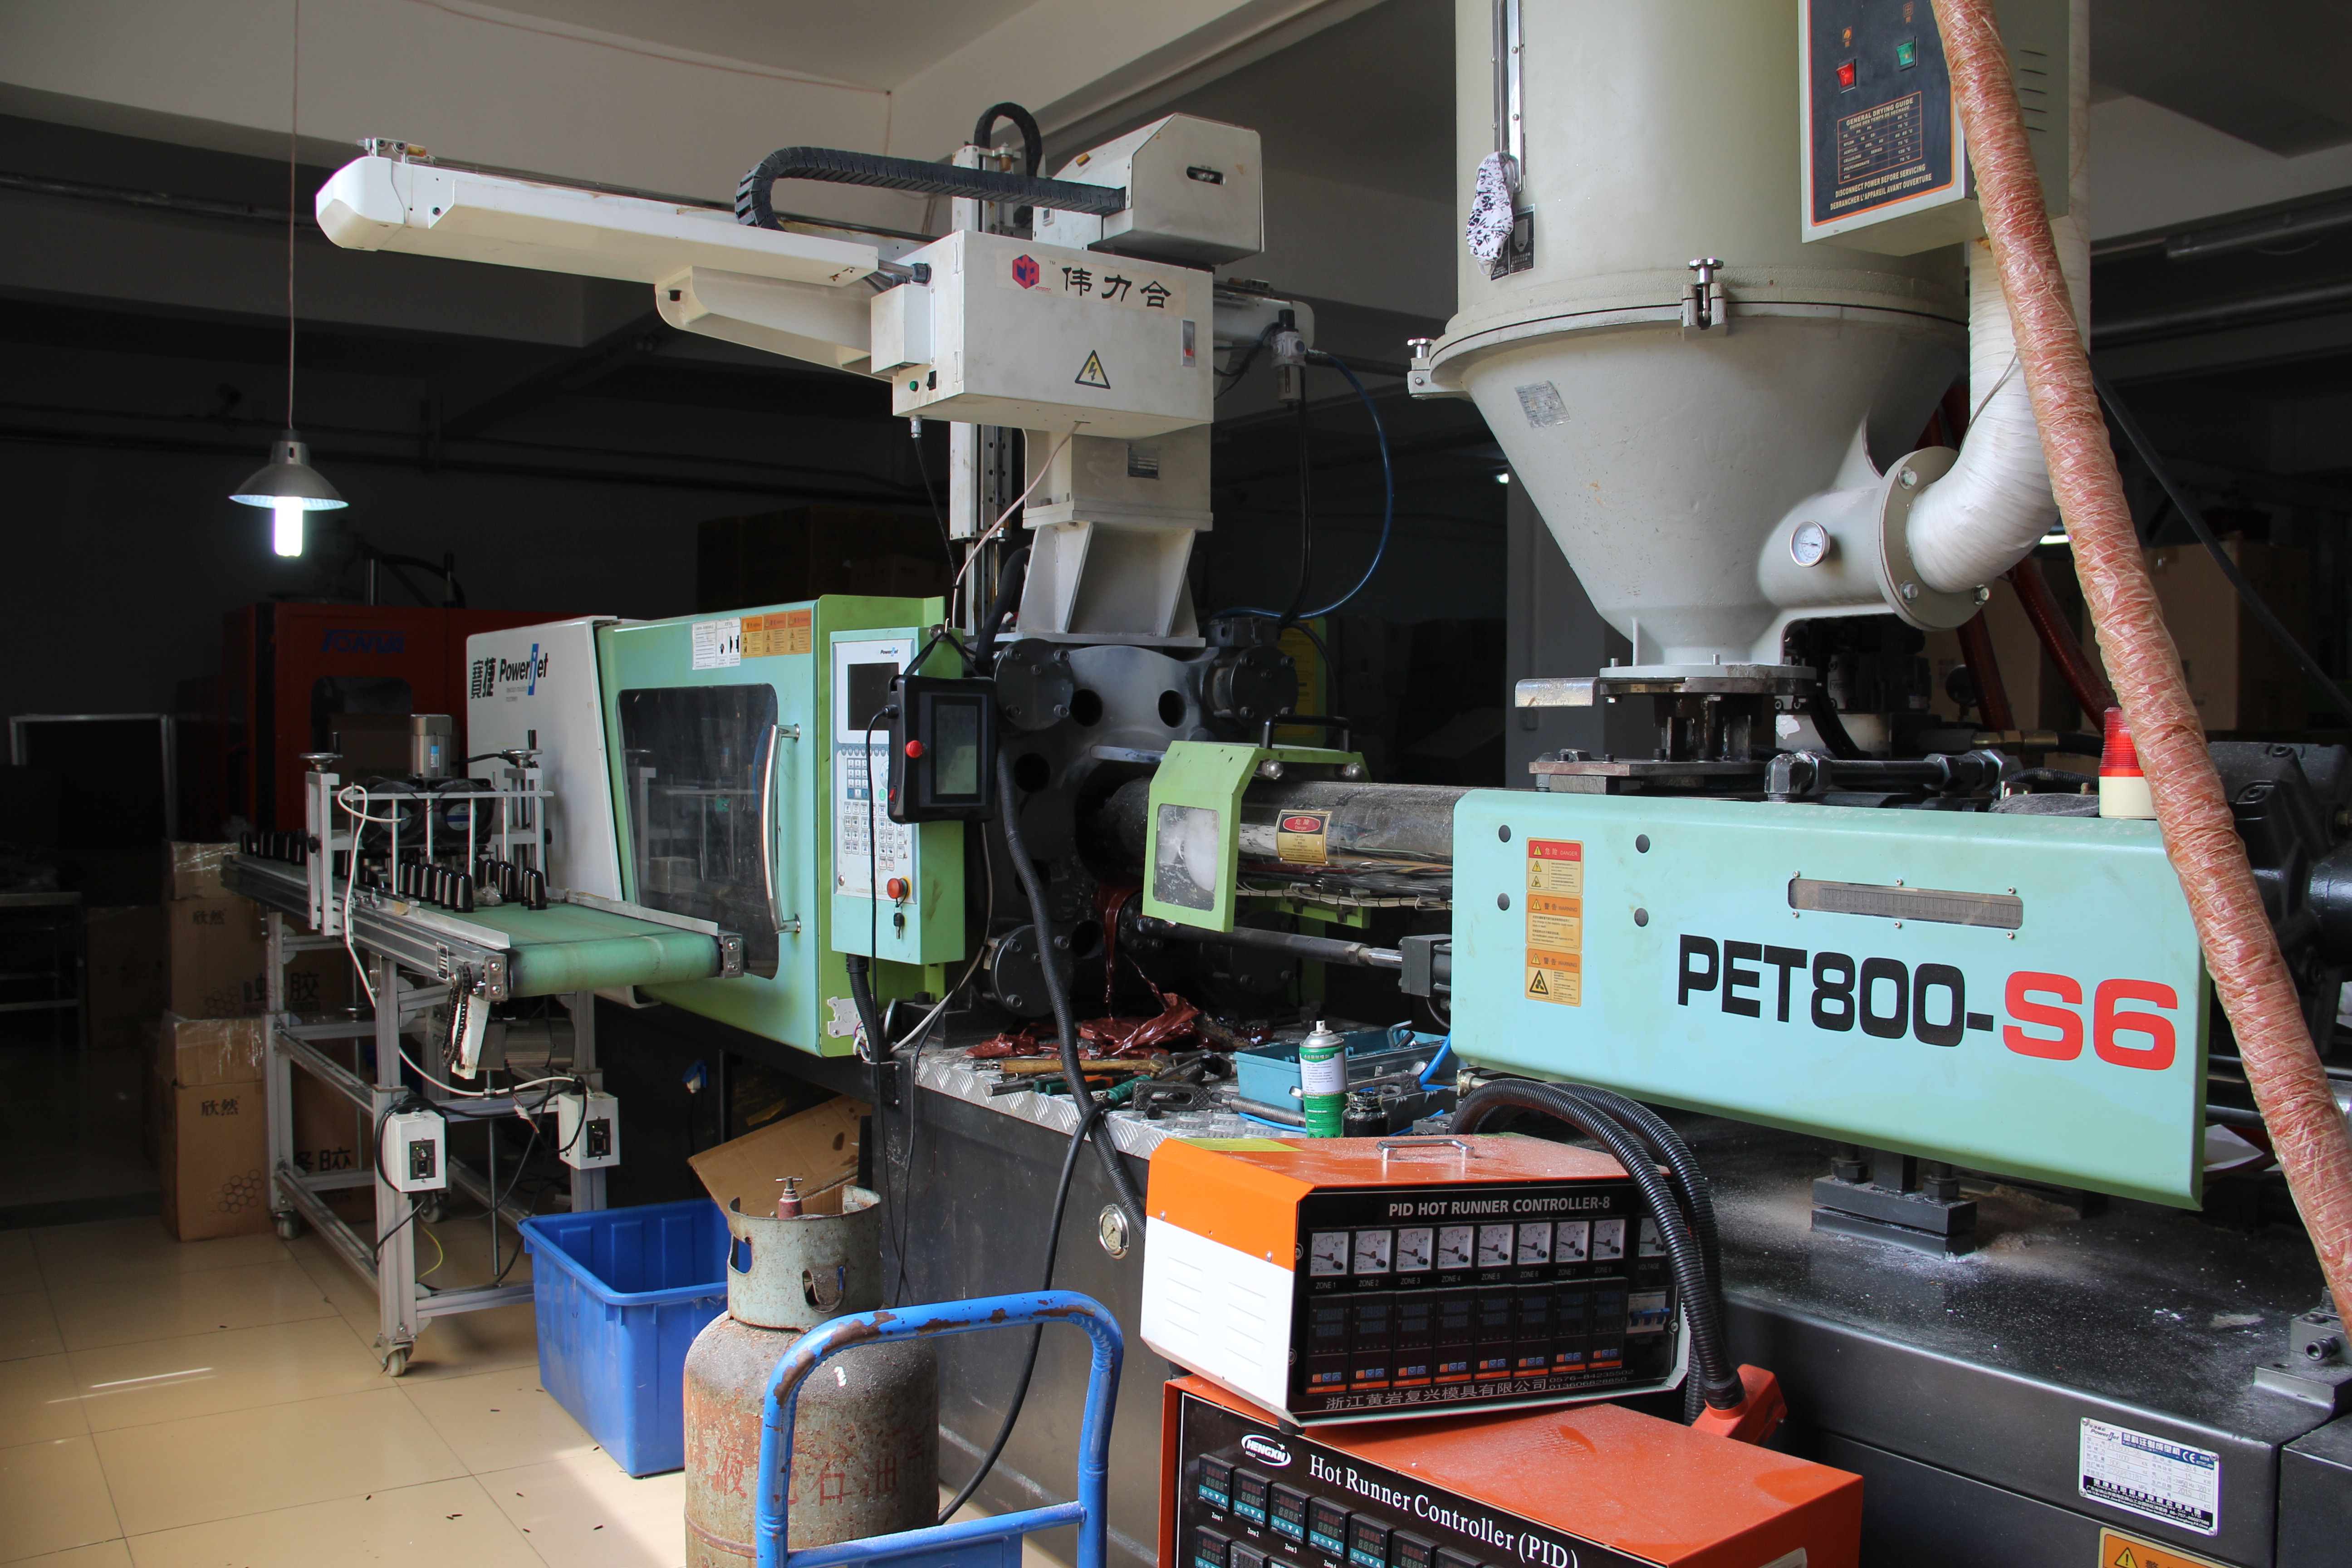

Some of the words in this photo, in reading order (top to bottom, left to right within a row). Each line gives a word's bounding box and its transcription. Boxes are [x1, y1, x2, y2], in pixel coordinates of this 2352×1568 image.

[1846, 113, 1872, 126] GENERAL
[1873, 104, 1894, 117] DRYING
[1895, 97, 1913, 109] GUIDE
[1891, 105, 1910, 116] SECHAGE
[1843, 160, 1870, 171] POLYCARBONATE
[1835, 183, 1864, 198] DISCONNECT
[1864, 178, 1880, 189] POWER
[1881, 172, 1899, 184] BEFORE
[1900, 163, 1926, 178] SERVICING
[1830, 195, 1860, 210] DEBRANCHER
[1860, 187, 1886, 201] L'APPAREIL
[1887, 183, 1902, 194] AVANT
[1902, 173, 1932, 188] OUVERTURE
[1062, 267, 1171, 309] 伟力合
[1678, 934, 2178, 1070] PET800-S6
[201, 1098, 239, 1116] 欣然
[1389, 1202, 1413, 1217] PID
[1418, 1201, 1447, 1216] HOT
[1451, 1199, 1510, 1215] RUNNER
[1512, 1196, 1611, 1213] CONTROLLER-8
[1549, 1369, 1635, 1382] 0576-84235502
[1325, 1378, 1546, 1410] 浙江黄岩复兴模具有限公司
[2178, 1487, 2191, 1496] 2015
[1309, 1454, 1342, 1487] Hot
[1346, 1467, 1411, 1510] Runner
[1414, 1494, 1514, 1550] Controller
[1519, 1532, 1578, 1568] (PID)
[1247, 1527, 1255, 1537] Zone
[1284, 1543, 1294, 1553] Zone
